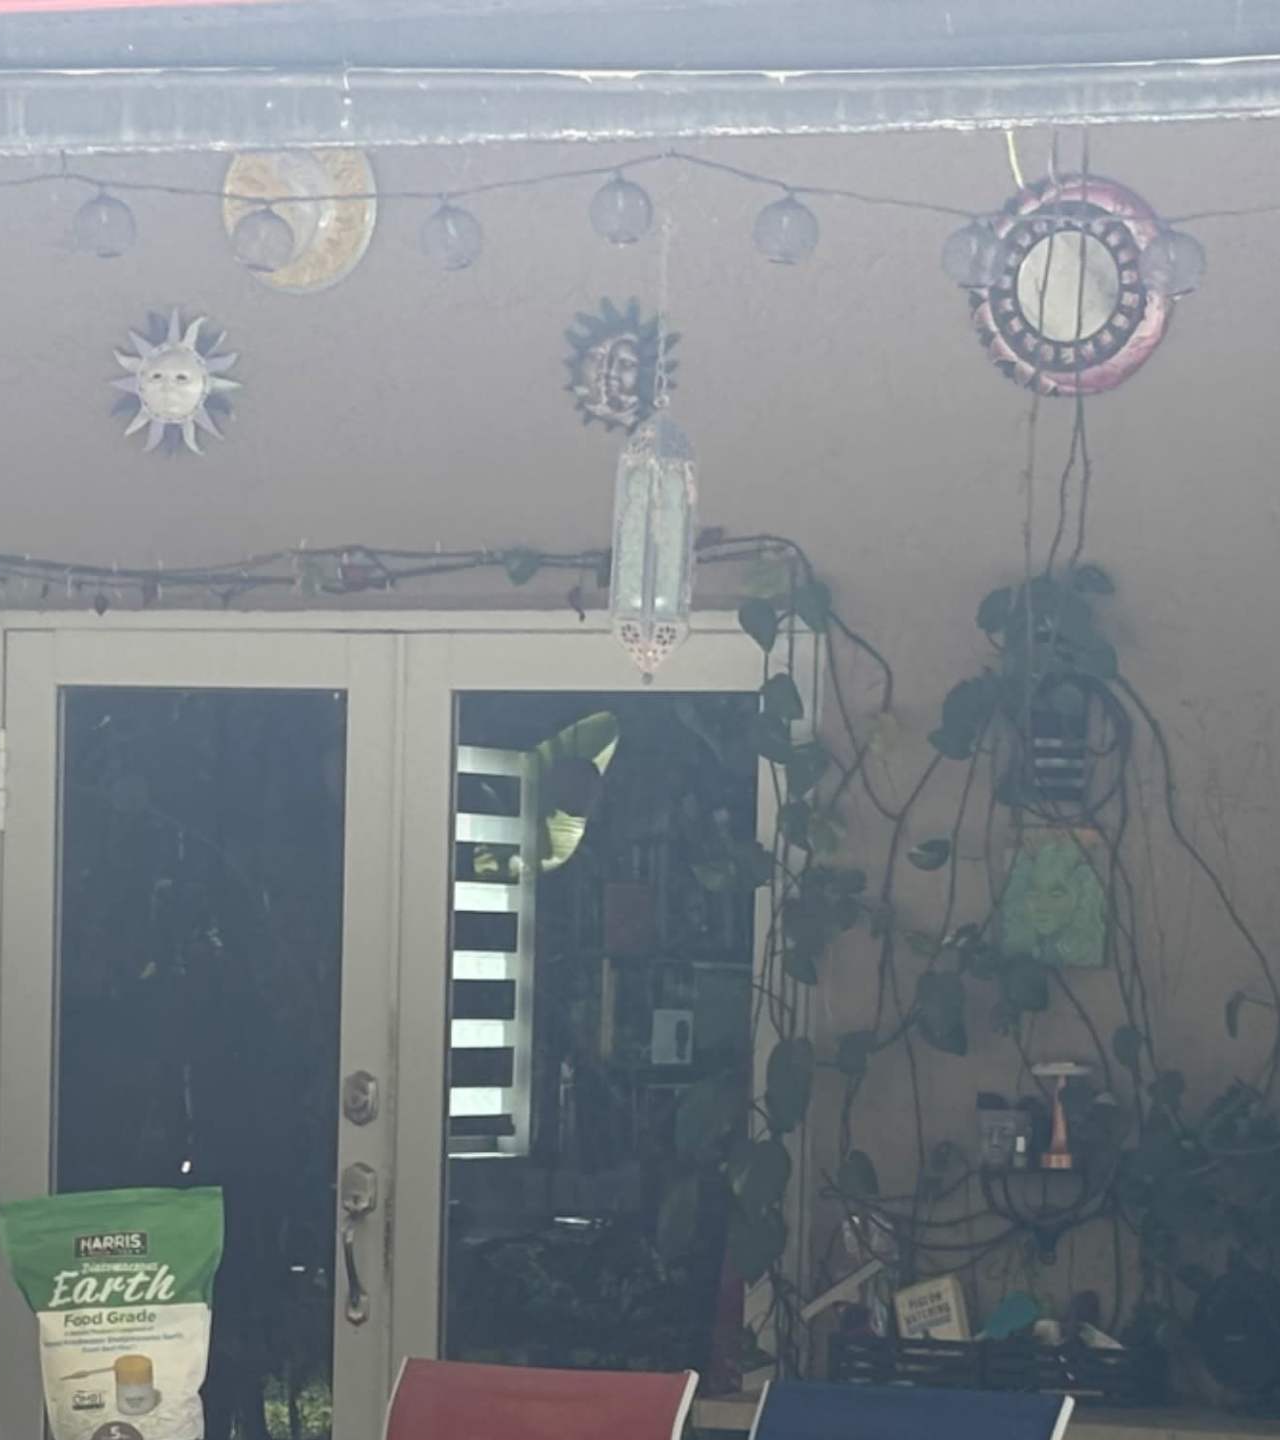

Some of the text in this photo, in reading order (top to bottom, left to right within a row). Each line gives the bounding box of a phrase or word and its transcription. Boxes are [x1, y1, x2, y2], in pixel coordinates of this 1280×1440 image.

[80, 1233, 142, 1251] HARRIS
[48, 1264, 175, 1308] Earth
[64, 1309, 157, 1328] Food Grade
